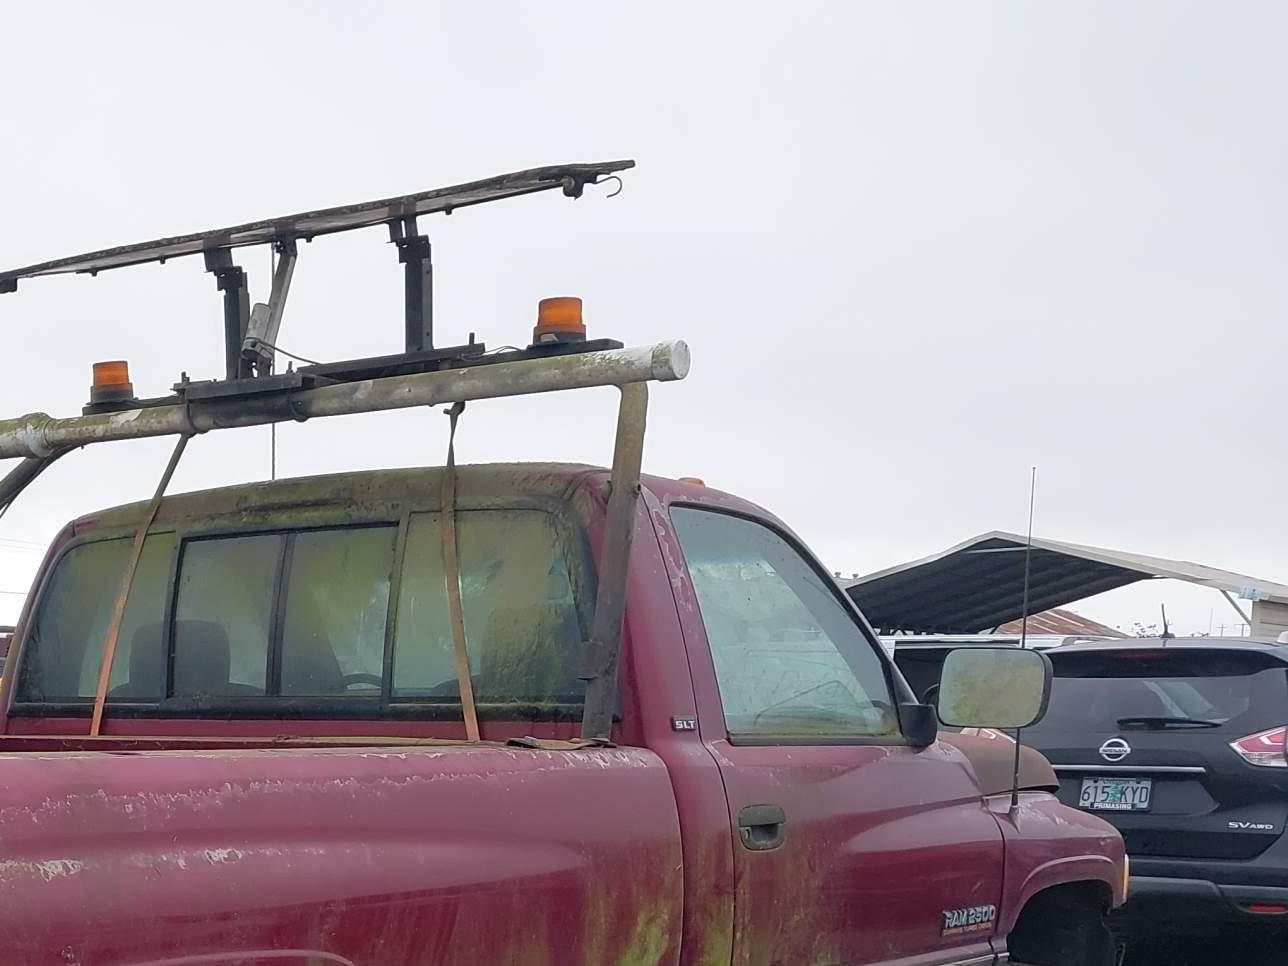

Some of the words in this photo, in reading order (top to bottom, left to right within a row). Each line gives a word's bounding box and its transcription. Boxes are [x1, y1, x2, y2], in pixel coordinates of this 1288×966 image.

[675, 720, 695, 729] SLT
[1081, 785, 1110, 802] 615
[1119, 786, 1149, 803] KYD
[943, 908, 968, 929] RAM
[968, 904, 996, 924] 2500
